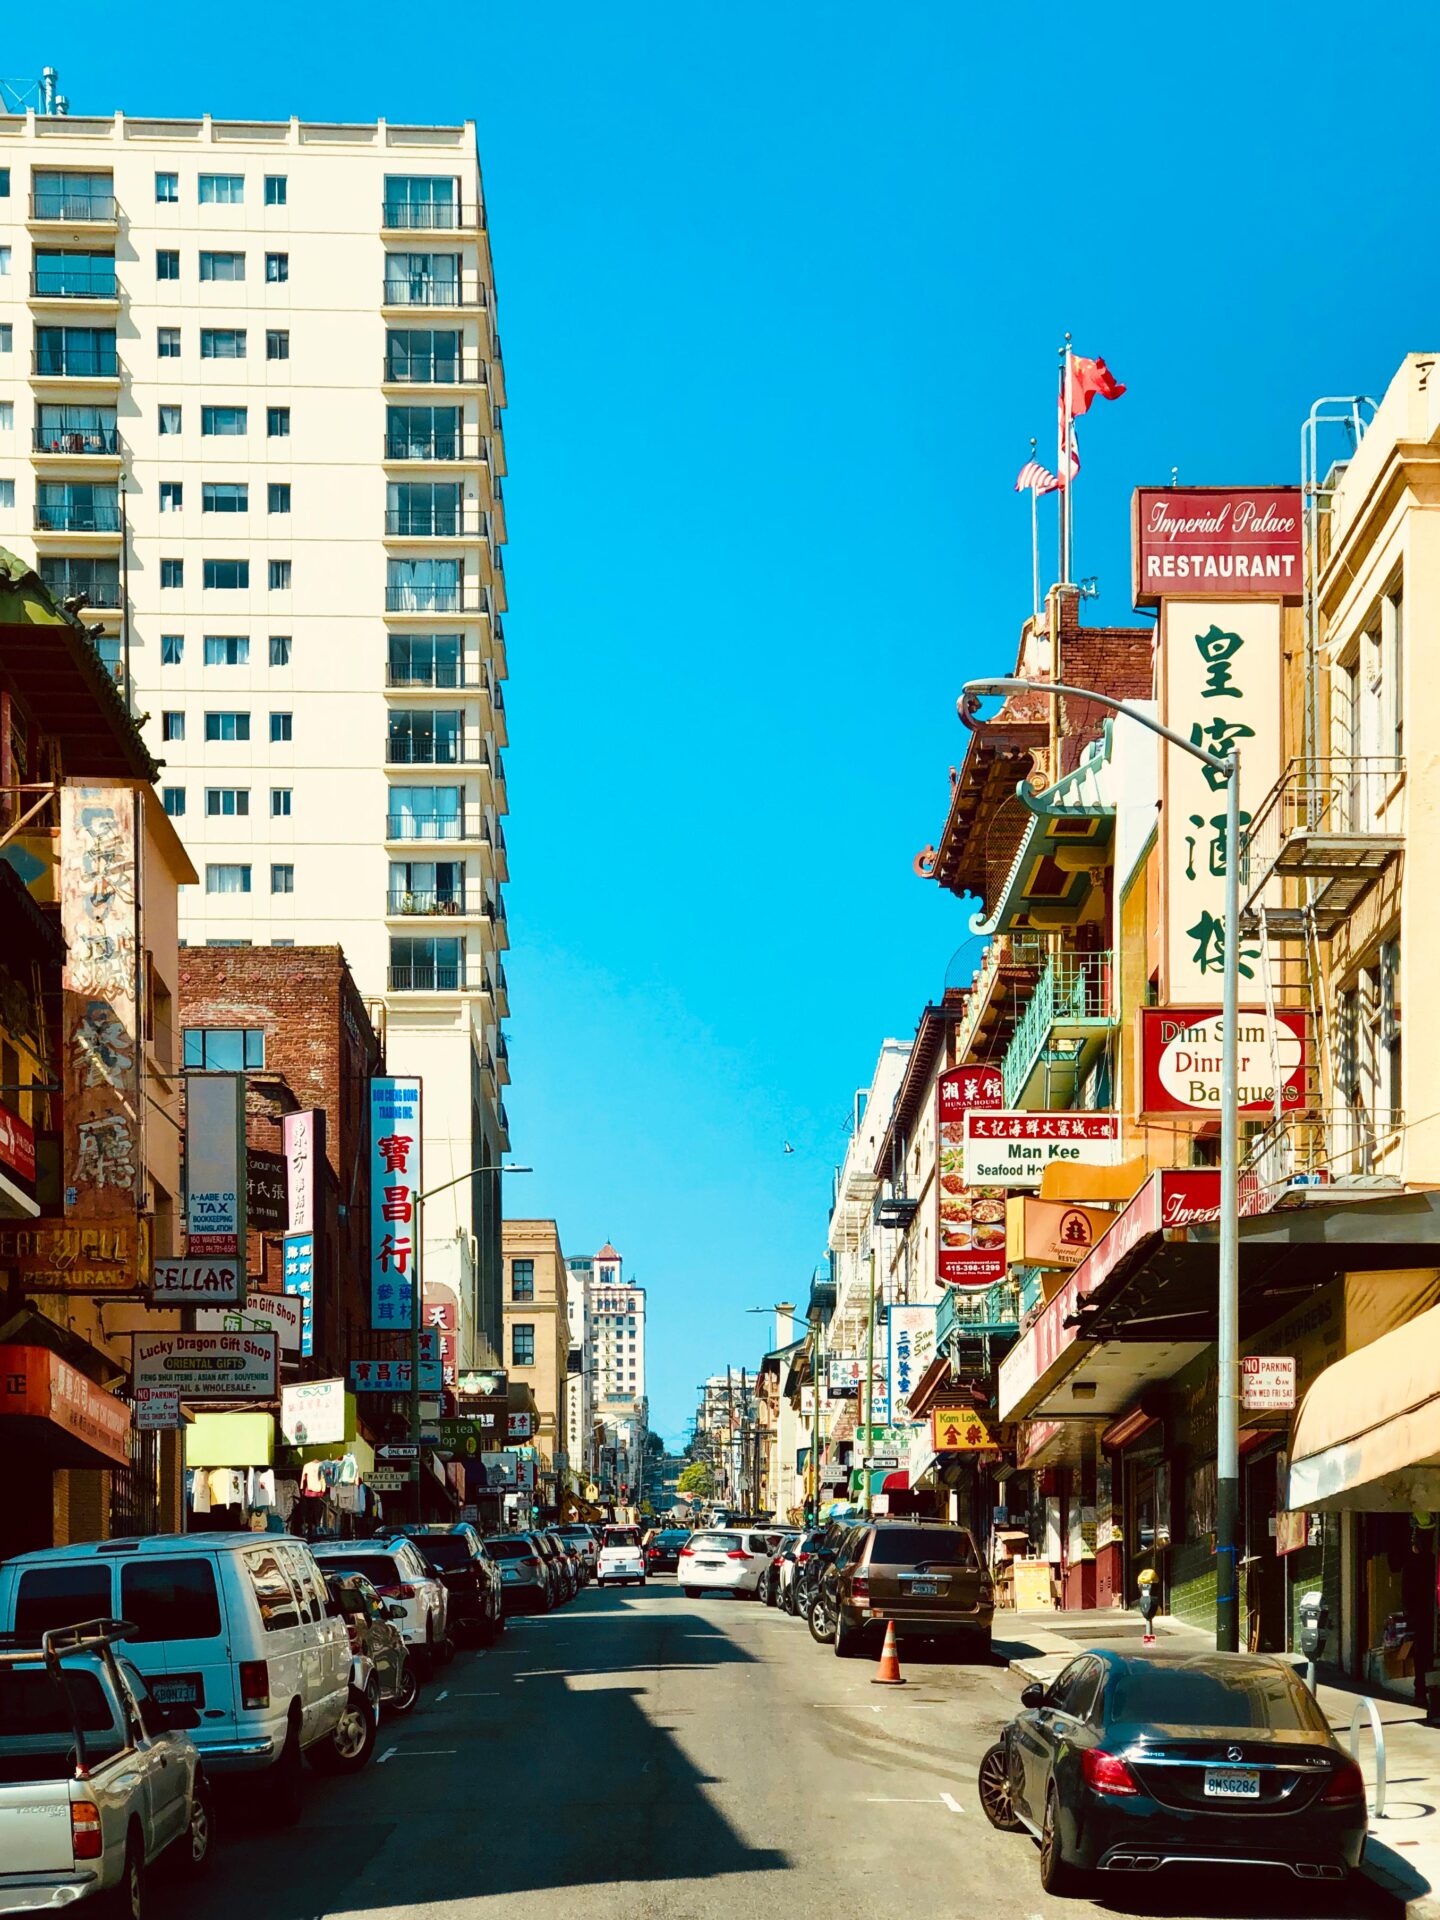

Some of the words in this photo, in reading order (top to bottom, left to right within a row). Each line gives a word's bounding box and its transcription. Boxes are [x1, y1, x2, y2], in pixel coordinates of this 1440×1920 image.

[1147, 501, 1231, 541] Imperial
[1232, 501, 1295, 533] Palace
[1147, 555, 1295, 577] RESTAURANT
[1161, 1021, 1207, 1043] Dim
[1008, 1144, 1041, 1158] Man
[1048, 1144, 1080, 1158] Kee
[977, 1164, 1023, 1175] Seafood
[223, 1193, 236, 1201] CO.
[197, 1203, 228, 1213] TAX
[376, 1134, 414, 1273] 寶昌行
[259, 1298, 275, 1314] Gift
[276, 1303, 296, 1326] Shop
[915, 1329, 934, 1343] San
[139, 1340, 174, 1361] Lucky
[176, 1338, 217, 1352] Dragon
[220, 1337, 241, 1352] Gift
[244, 1340, 272, 1362] Shop
[166, 1358, 213, 1369] ORIENTAL
[216, 1358, 245, 1369] GIFTS
[1244, 1359, 1258, 1372] NO
[1261, 1363, 1292, 1372] PARKING
[195, 1384, 201, 1392] &
[203, 1384, 251, 1392] WHOLESALE
[1259, 1389, 1270, 1397] WED
[1272, 1389, 1281, 1397] FRI
[1283, 1389, 1292, 1397] SAT
[137, 1389, 149, 1400] NO
[151, 1391, 177, 1399] PARKING
[940, 1414, 959, 1423] Kam
[962, 1414, 978, 1422] Lok
[456, 1424, 474, 1434] tea
